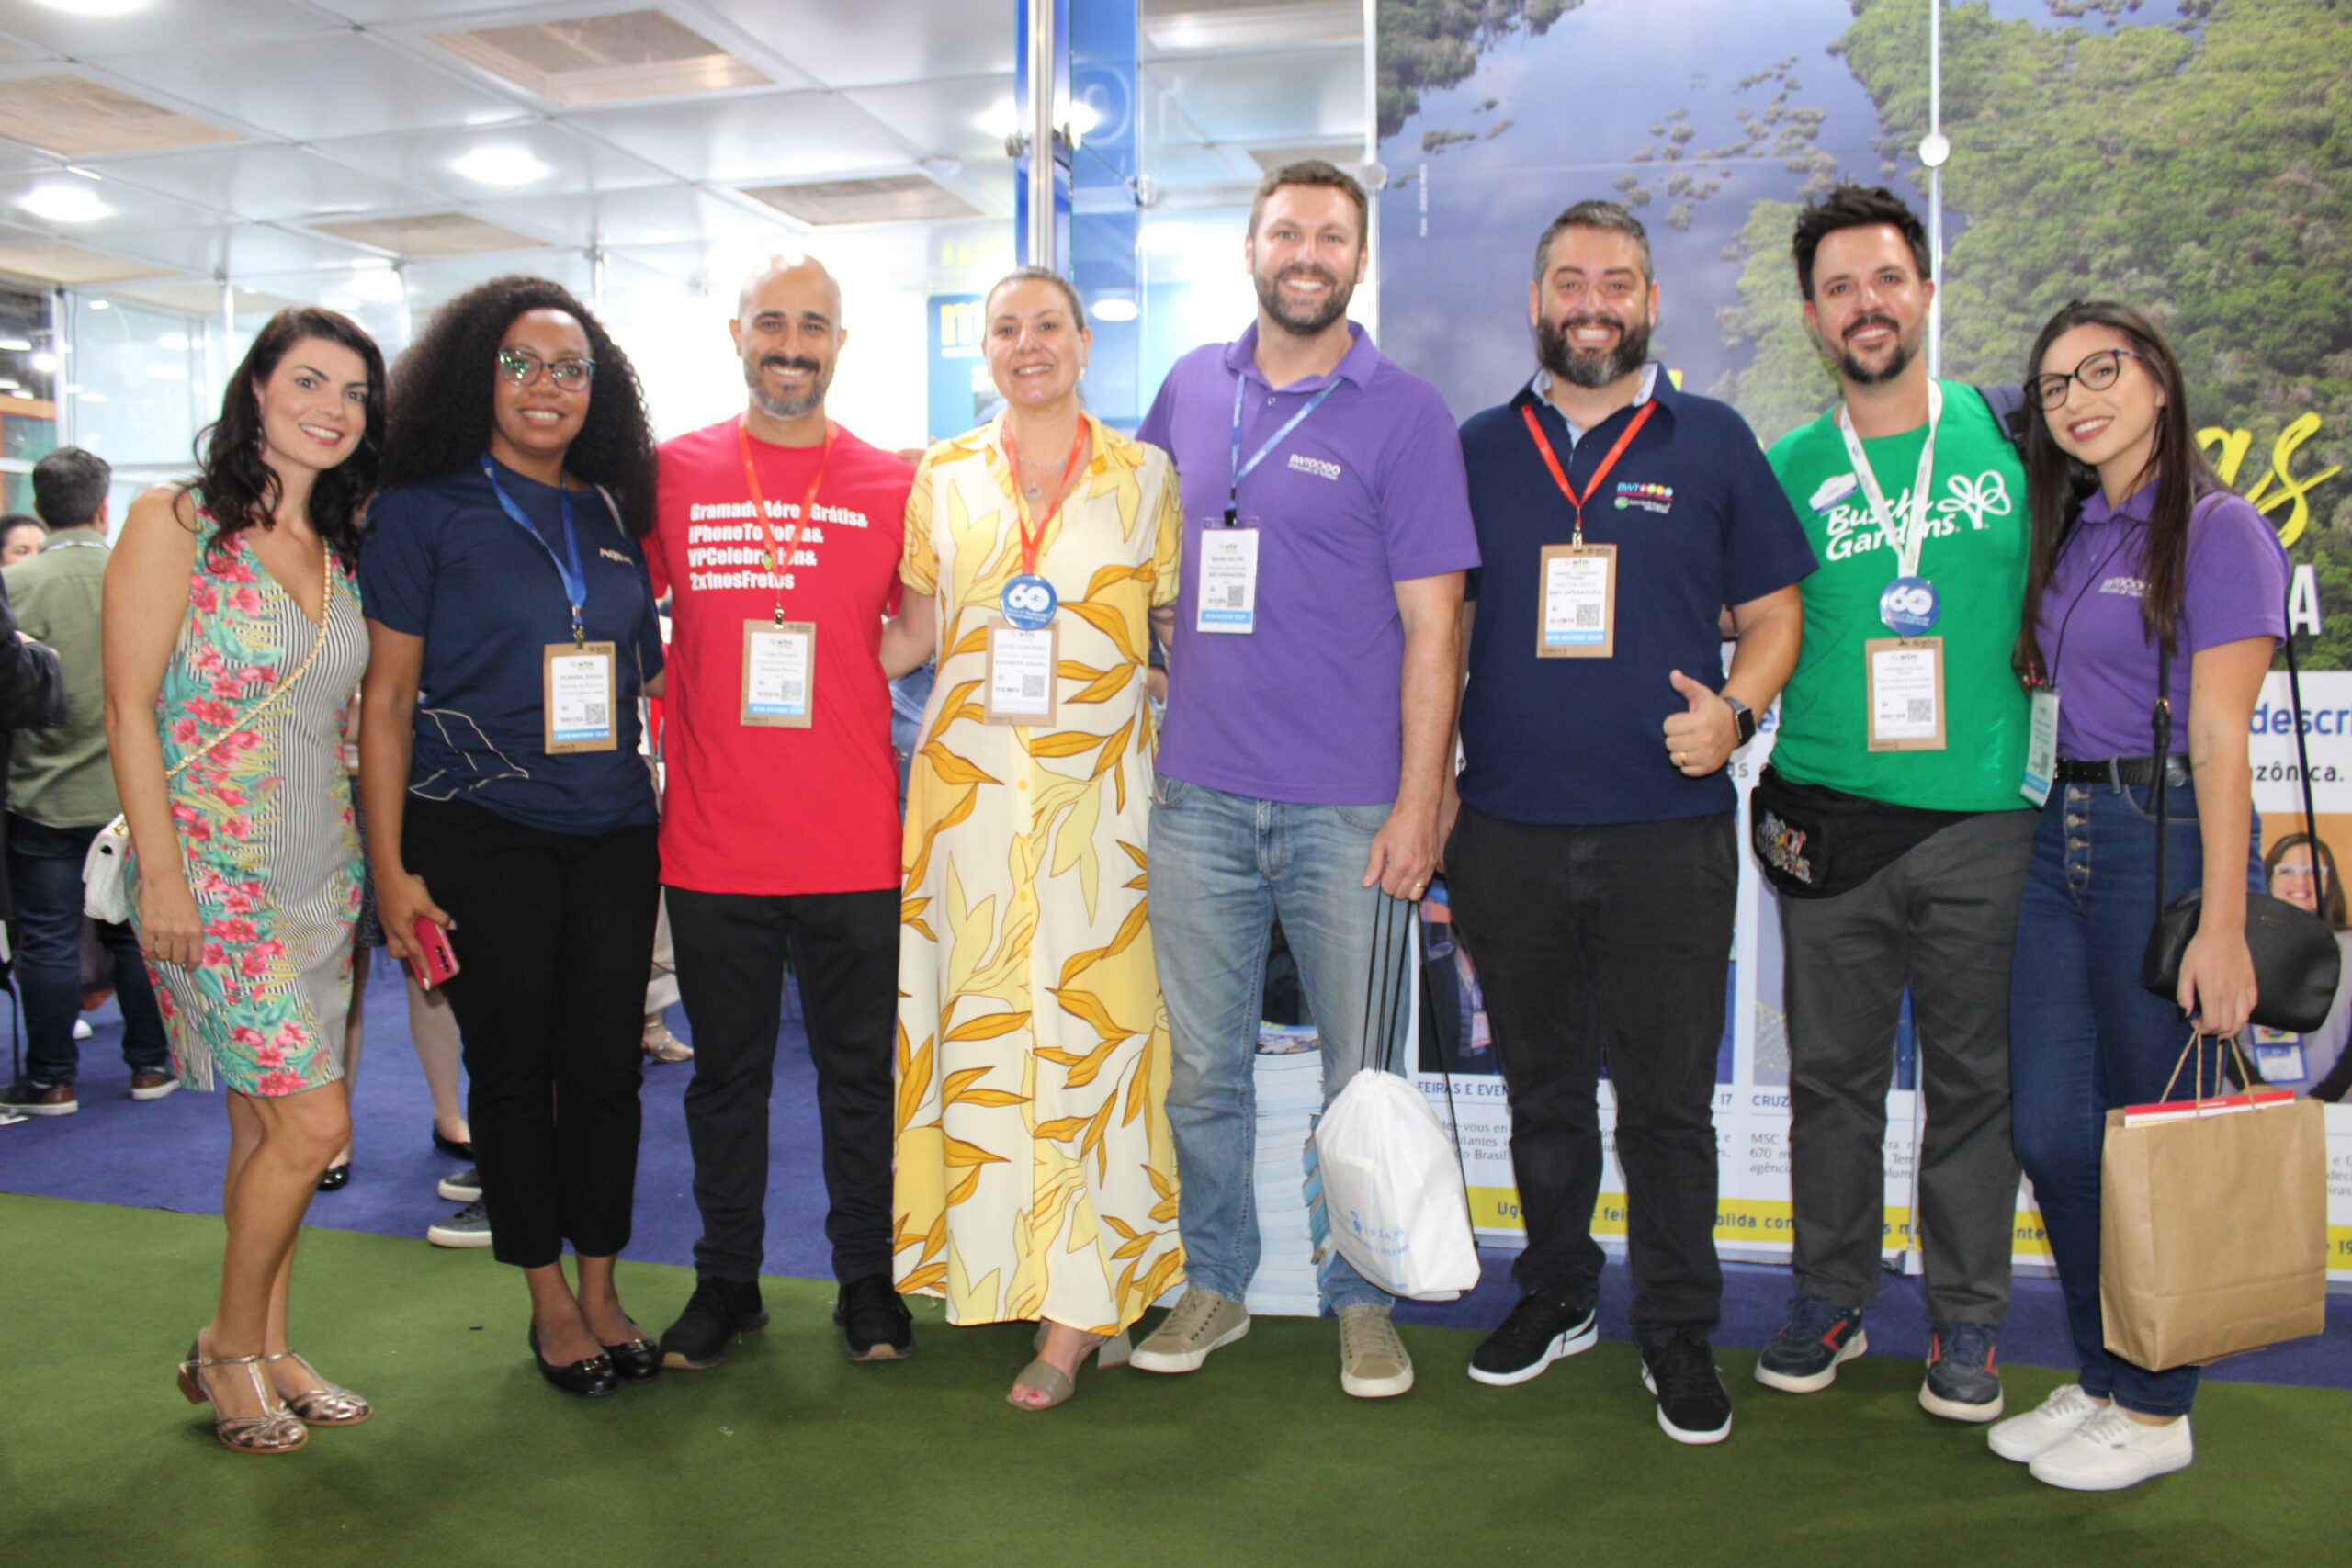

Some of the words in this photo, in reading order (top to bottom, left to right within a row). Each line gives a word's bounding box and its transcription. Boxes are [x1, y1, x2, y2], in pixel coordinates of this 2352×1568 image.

[1826, 513, 1956, 561] Gardns
[2249, 702, 2352, 735] descr
[2251, 761, 2344, 782] zônca.
